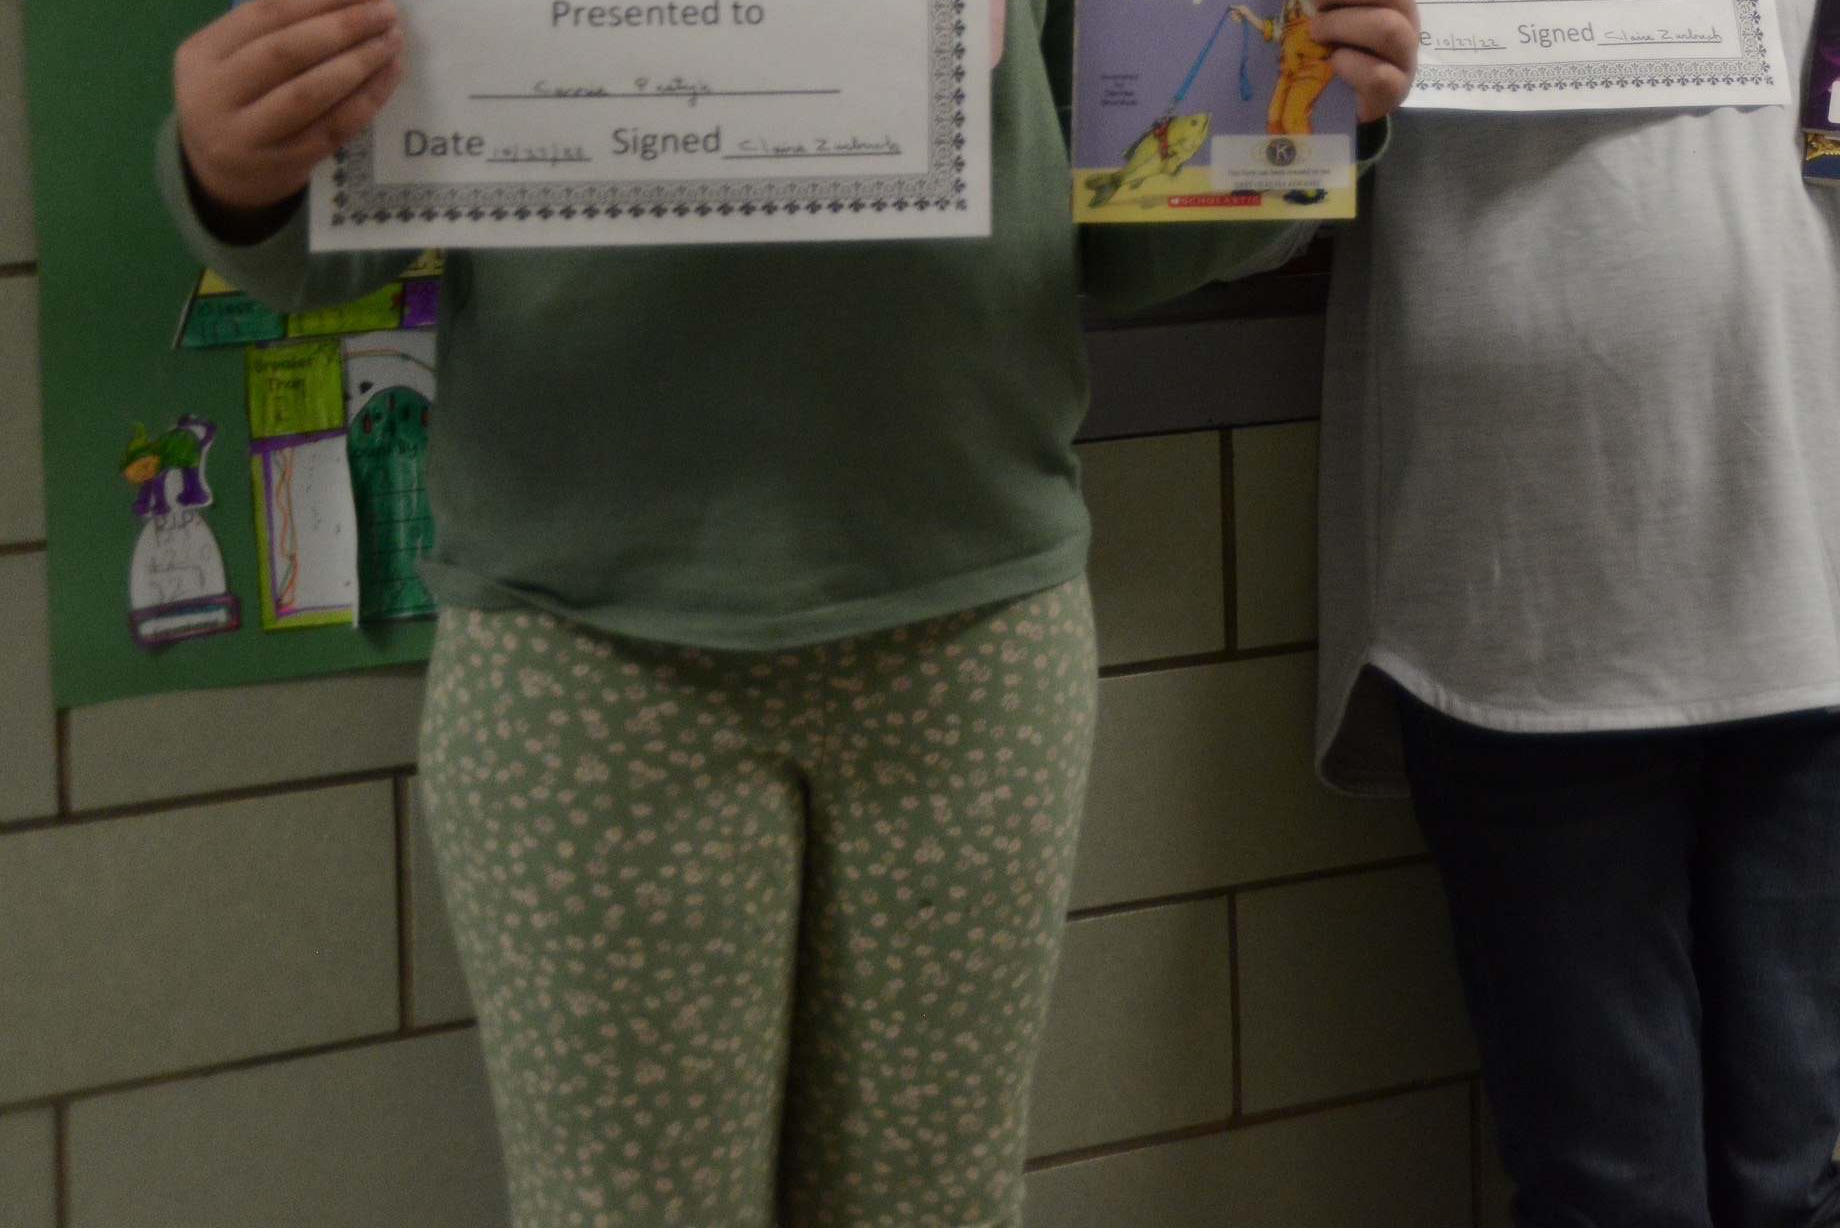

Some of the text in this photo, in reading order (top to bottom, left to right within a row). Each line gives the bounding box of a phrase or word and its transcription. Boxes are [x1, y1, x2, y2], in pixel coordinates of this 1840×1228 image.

[732, 0, 765, 26] to
[1518, 22, 1595, 48] Signed
[404, 129, 486, 159] Date
[611, 126, 721, 160] Signed
